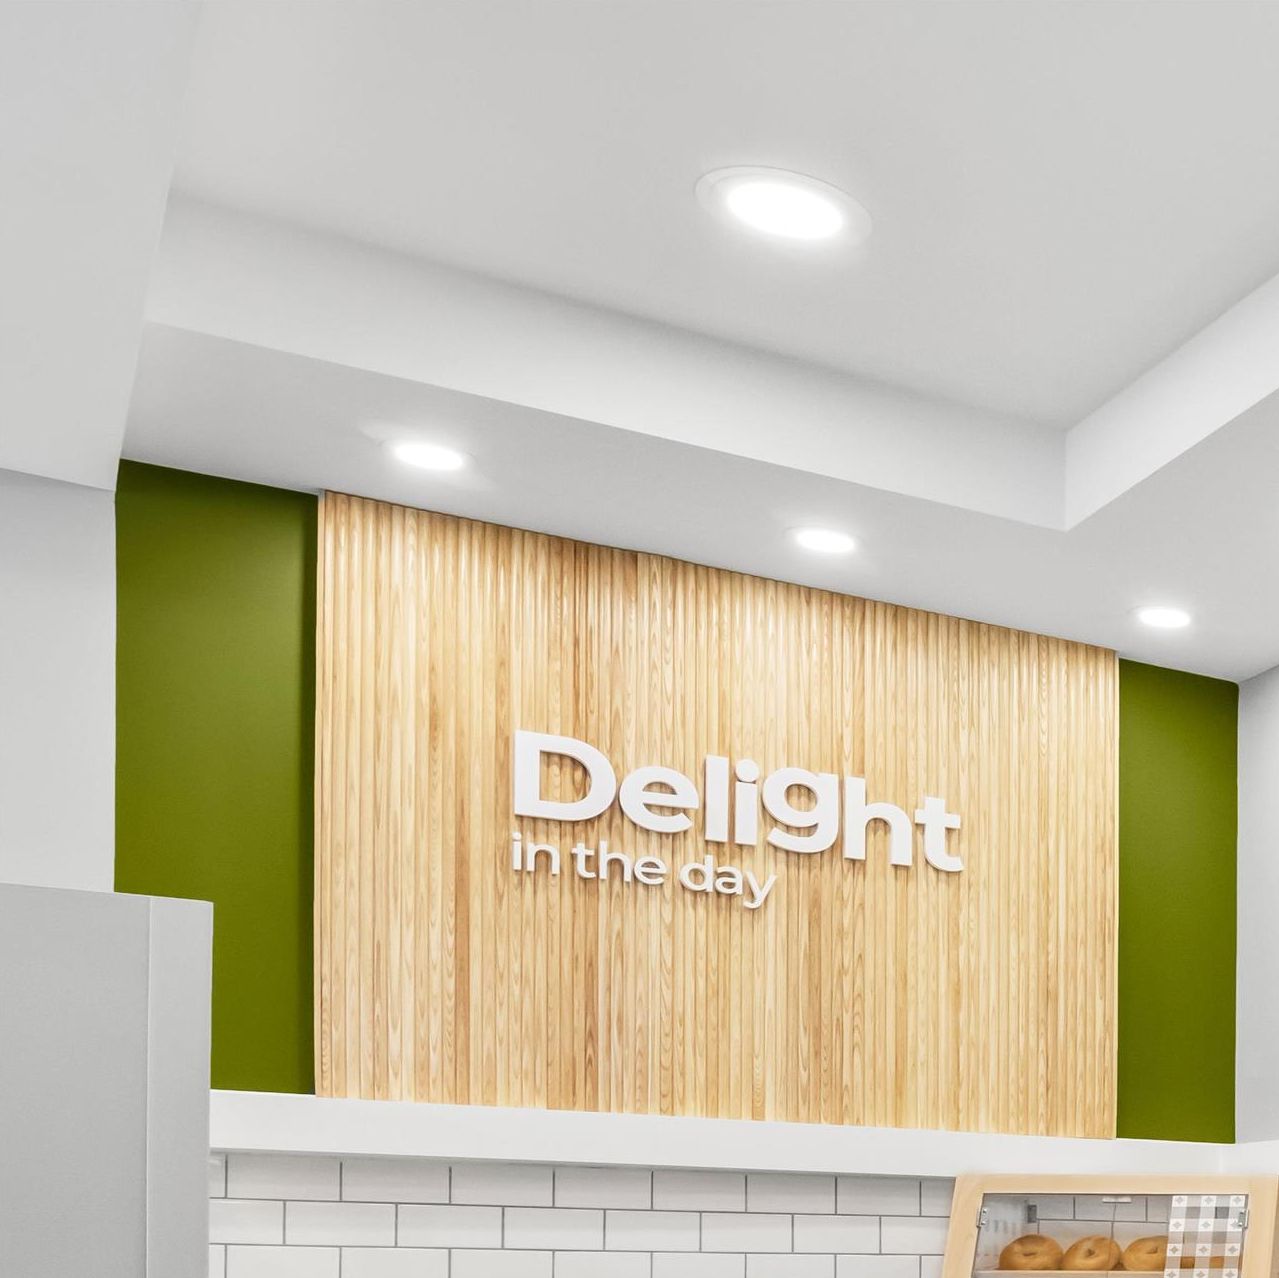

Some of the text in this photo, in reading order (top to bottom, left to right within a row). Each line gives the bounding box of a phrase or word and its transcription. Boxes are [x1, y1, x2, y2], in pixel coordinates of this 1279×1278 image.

[513, 729, 965, 873] Delight
[512, 832, 777, 909] in the day
